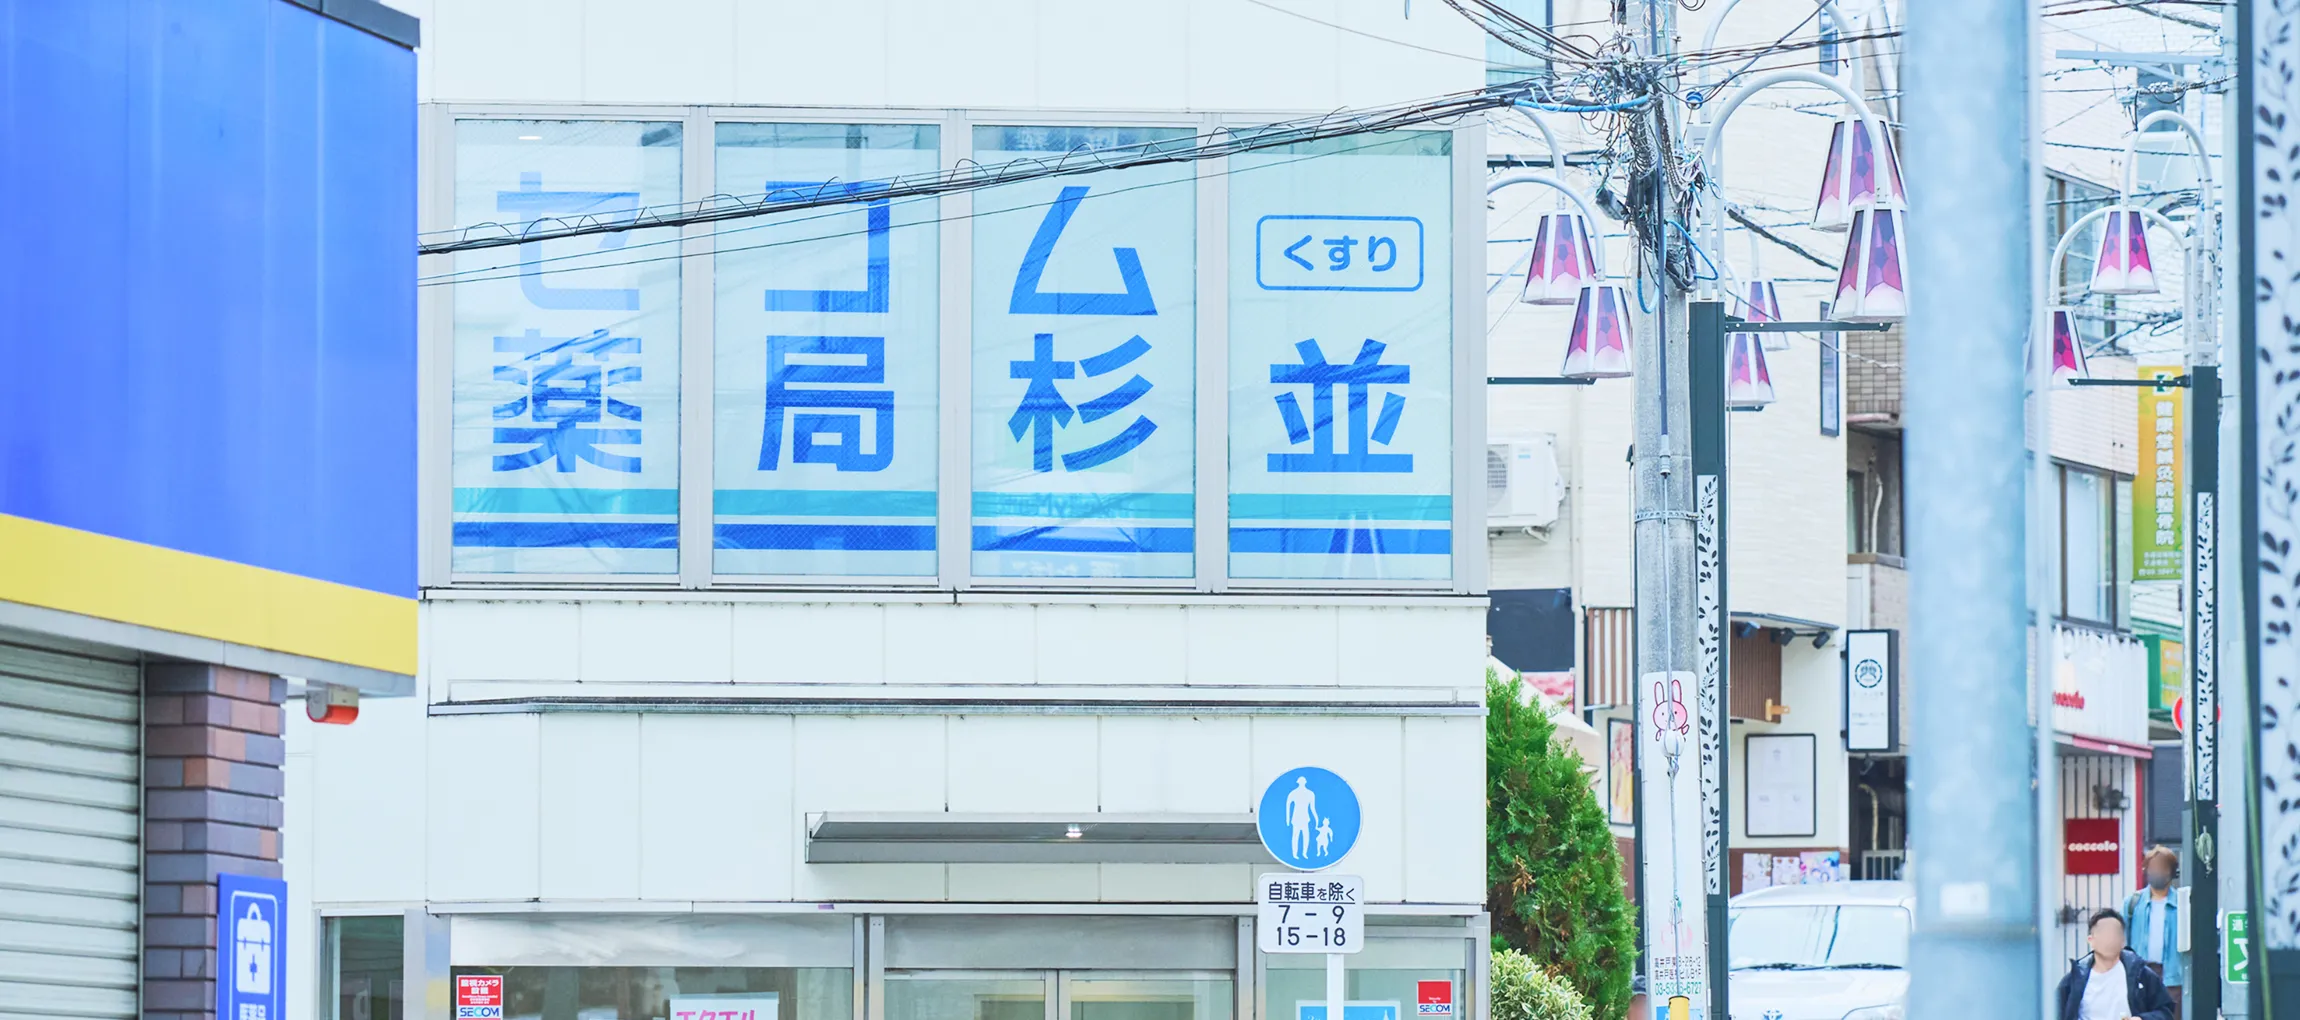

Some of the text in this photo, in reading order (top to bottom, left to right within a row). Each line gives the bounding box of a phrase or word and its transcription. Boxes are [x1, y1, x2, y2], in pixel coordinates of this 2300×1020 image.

[1283, 234, 1398, 272] くすり
[1268, 881, 1355, 902] 自転車を除く
[460, 1006, 500, 1017] SECOM
[1420, 1003, 1451, 1013] SECOM
